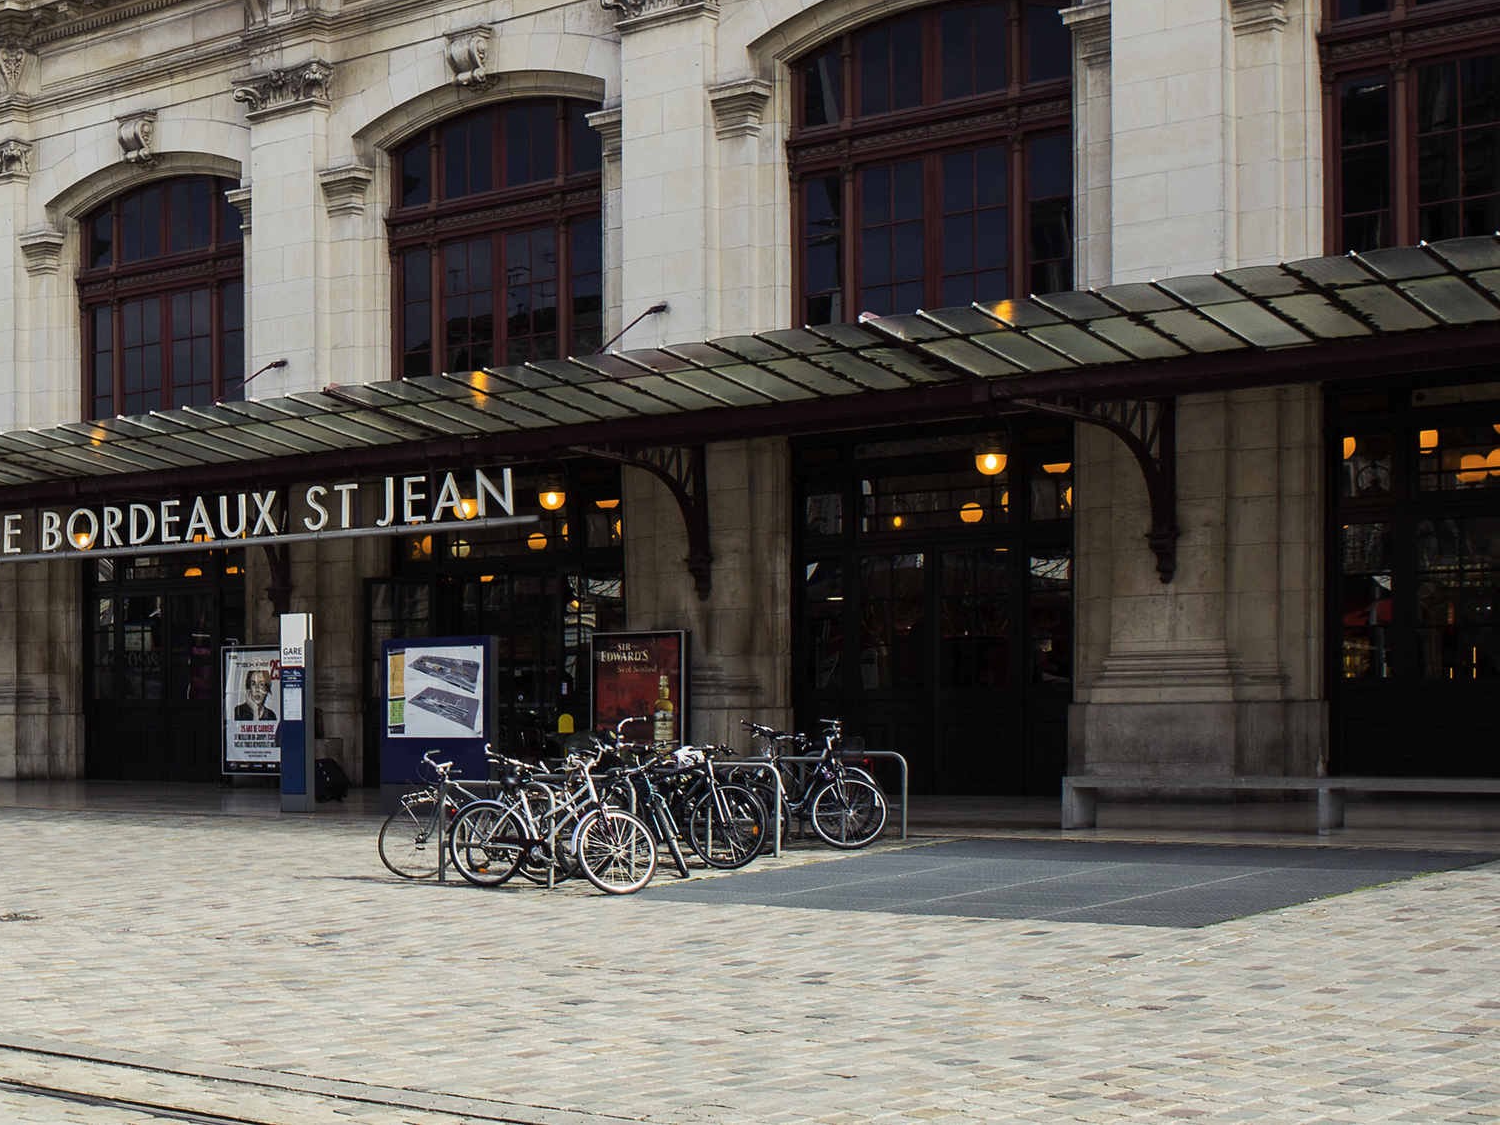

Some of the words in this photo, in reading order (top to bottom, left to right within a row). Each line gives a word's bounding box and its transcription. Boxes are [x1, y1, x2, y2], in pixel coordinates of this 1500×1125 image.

[42, 490, 279, 552] BORDEAUX
[304, 483, 358, 531] ST
[376, 467, 514, 527] JEAN
[283, 647, 303, 656] GARE
[617, 643, 632, 651] SIR
